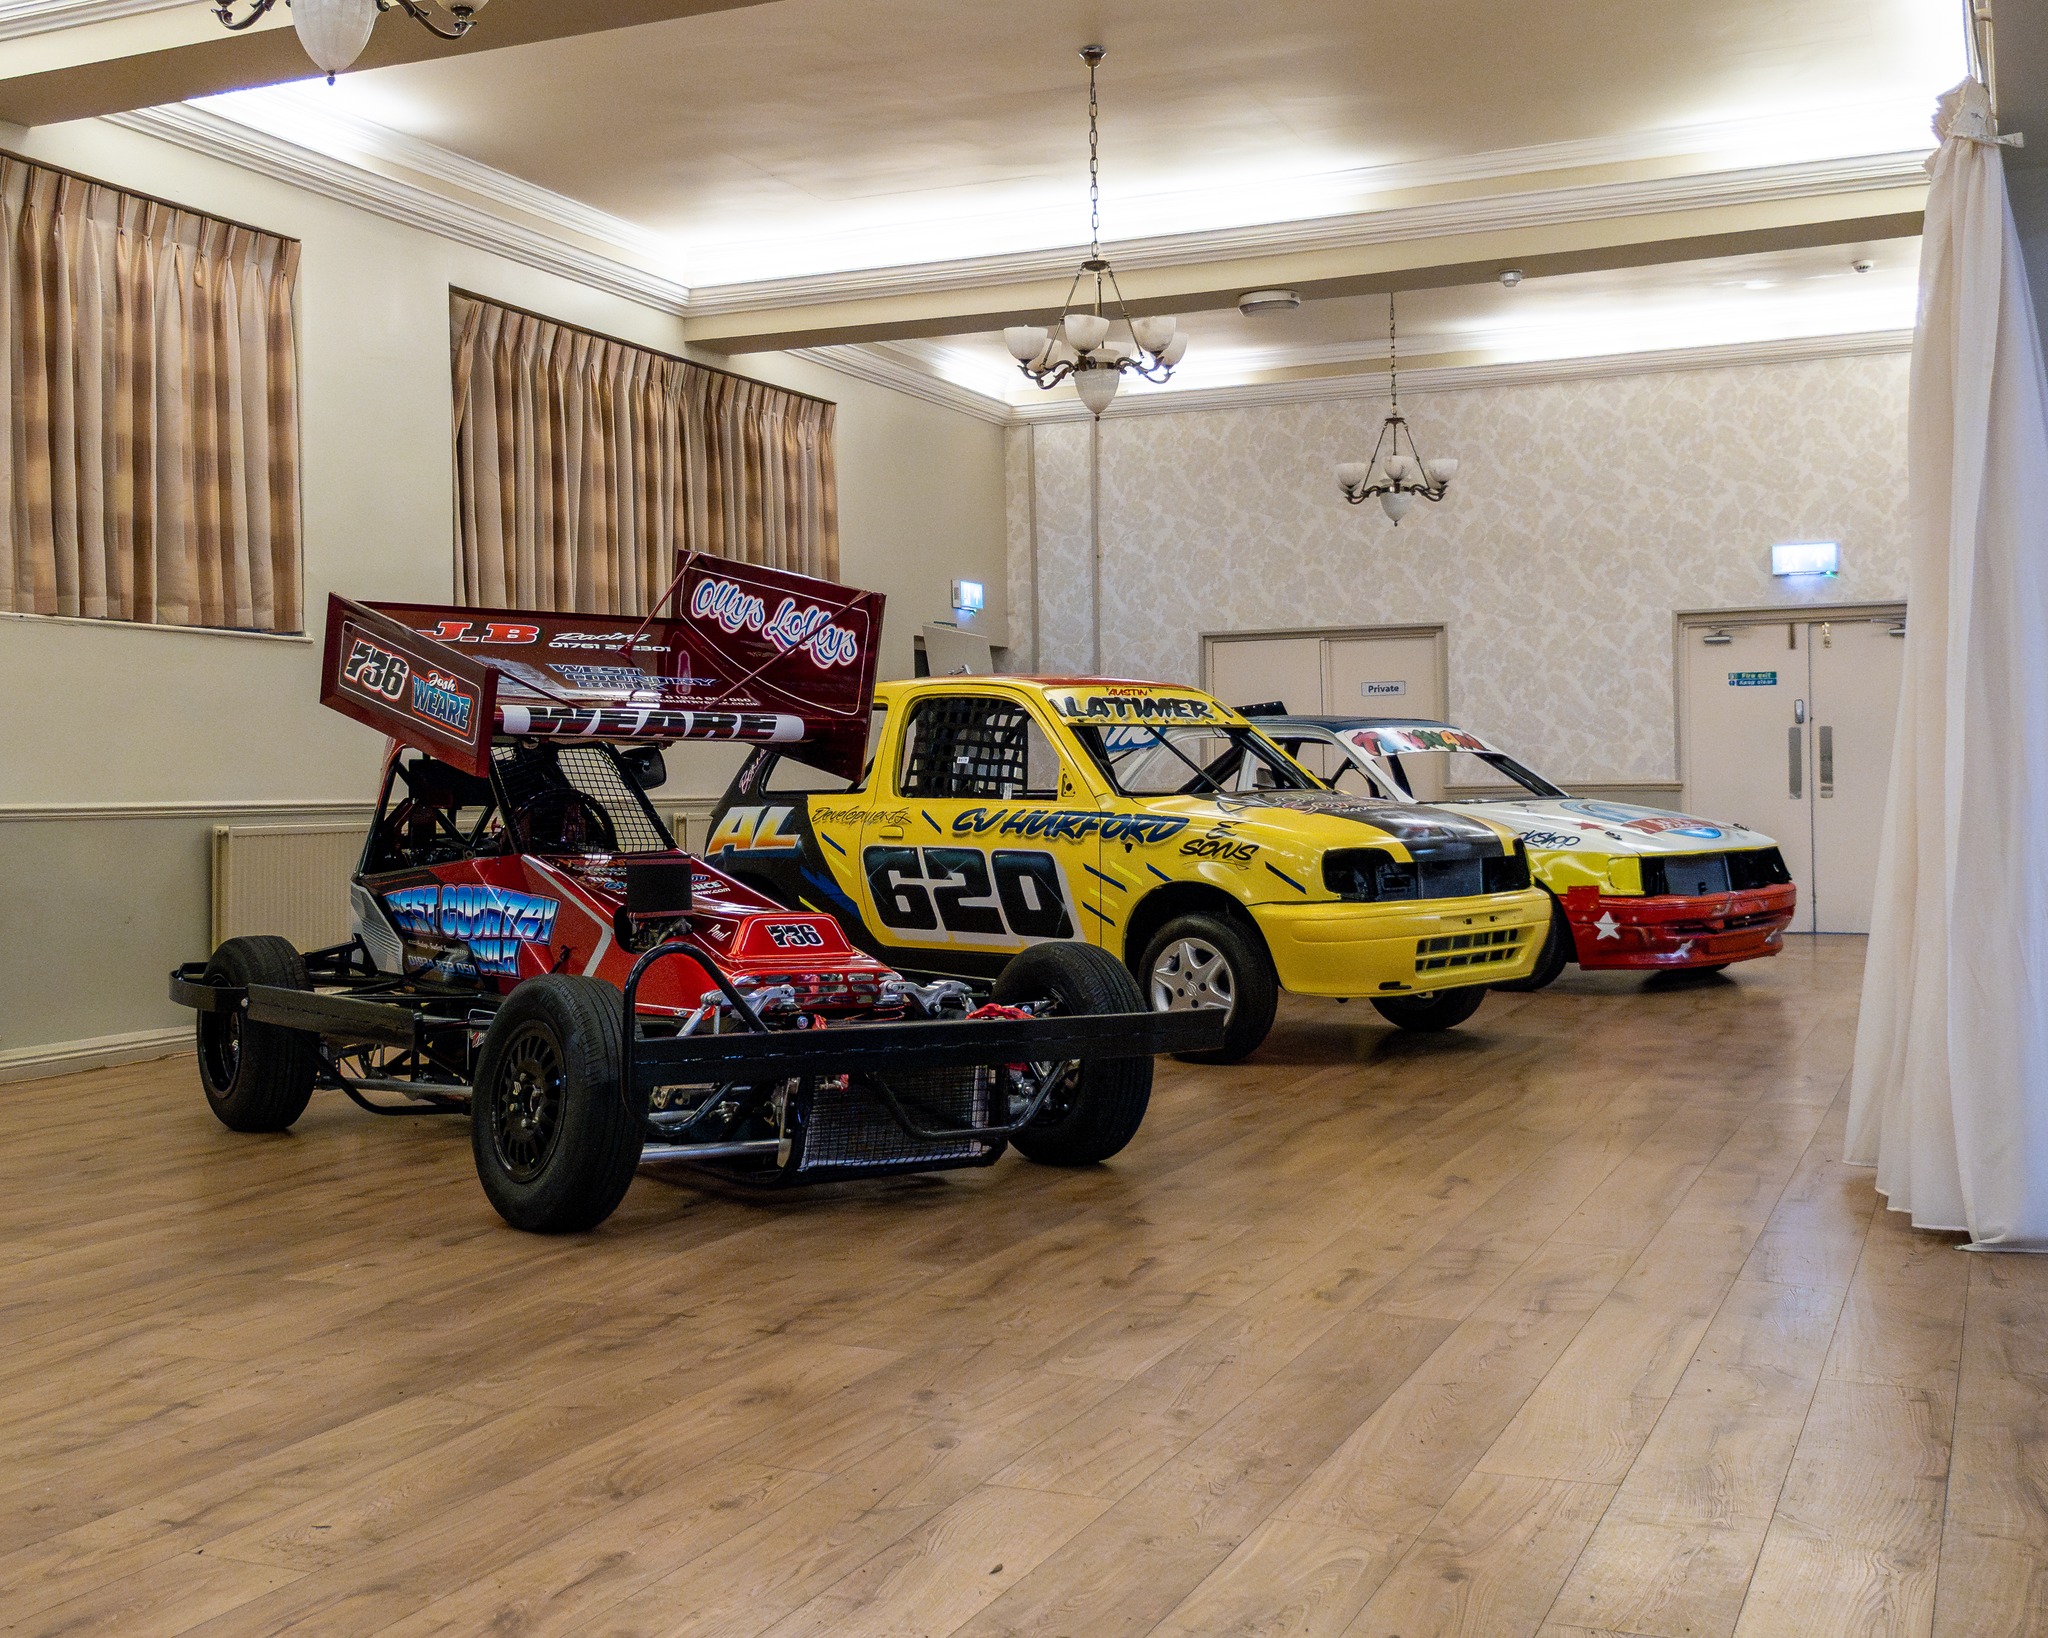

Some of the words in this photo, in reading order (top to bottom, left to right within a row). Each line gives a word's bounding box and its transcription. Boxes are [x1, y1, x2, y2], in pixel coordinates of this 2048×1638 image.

[691, 578, 765, 633] Ollys
[344, 638, 409, 702] 736
[428, 672, 456, 692] Josh
[1108, 688, 1147, 696] AUSTIN
[1368, 684, 1399, 693] Private
[412, 674, 472, 730] WEARE
[529, 706, 778, 739] WEARE
[1065, 696, 1214, 720] LATIMER
[705, 806, 801, 857] AL
[1001, 808, 1190, 844] HURFORD
[1178, 839, 1260, 860] SONS
[440, 884, 560, 943] COUNTRY
[862, 845, 1075, 939] 620
[765, 923, 824, 947] 736
